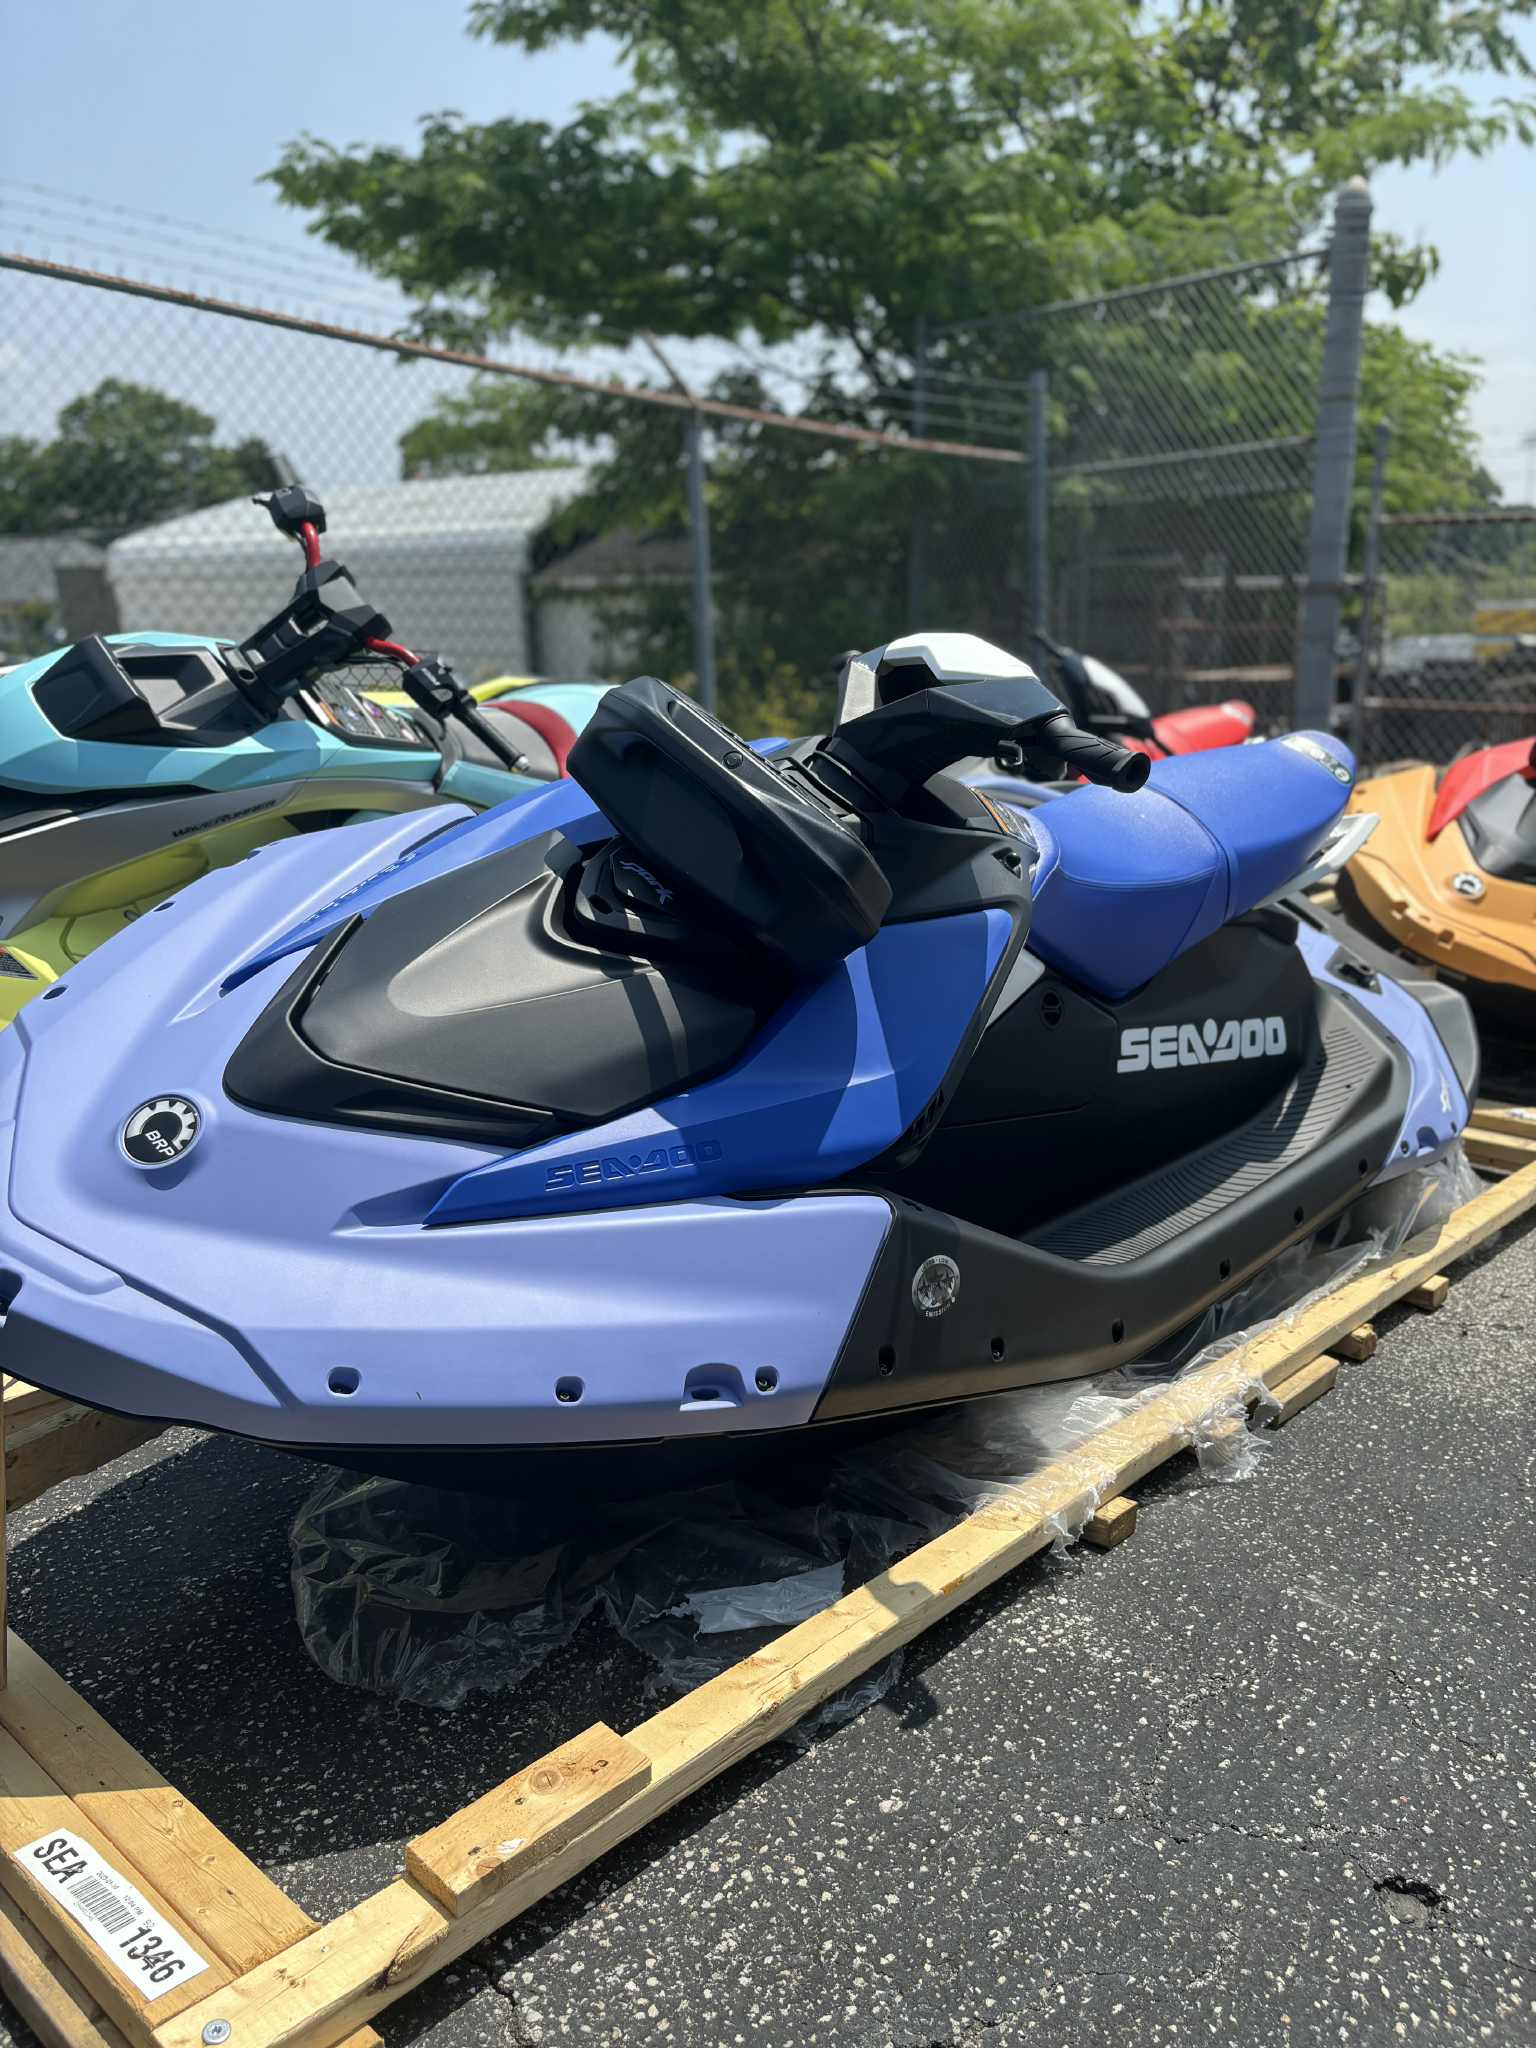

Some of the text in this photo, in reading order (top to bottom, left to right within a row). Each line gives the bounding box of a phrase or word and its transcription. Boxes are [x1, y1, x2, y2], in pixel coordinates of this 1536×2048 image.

[144, 1129, 176, 1156] BRP
[33, 1838, 88, 1884] SEA
[119, 1926, 186, 1983] 1346
